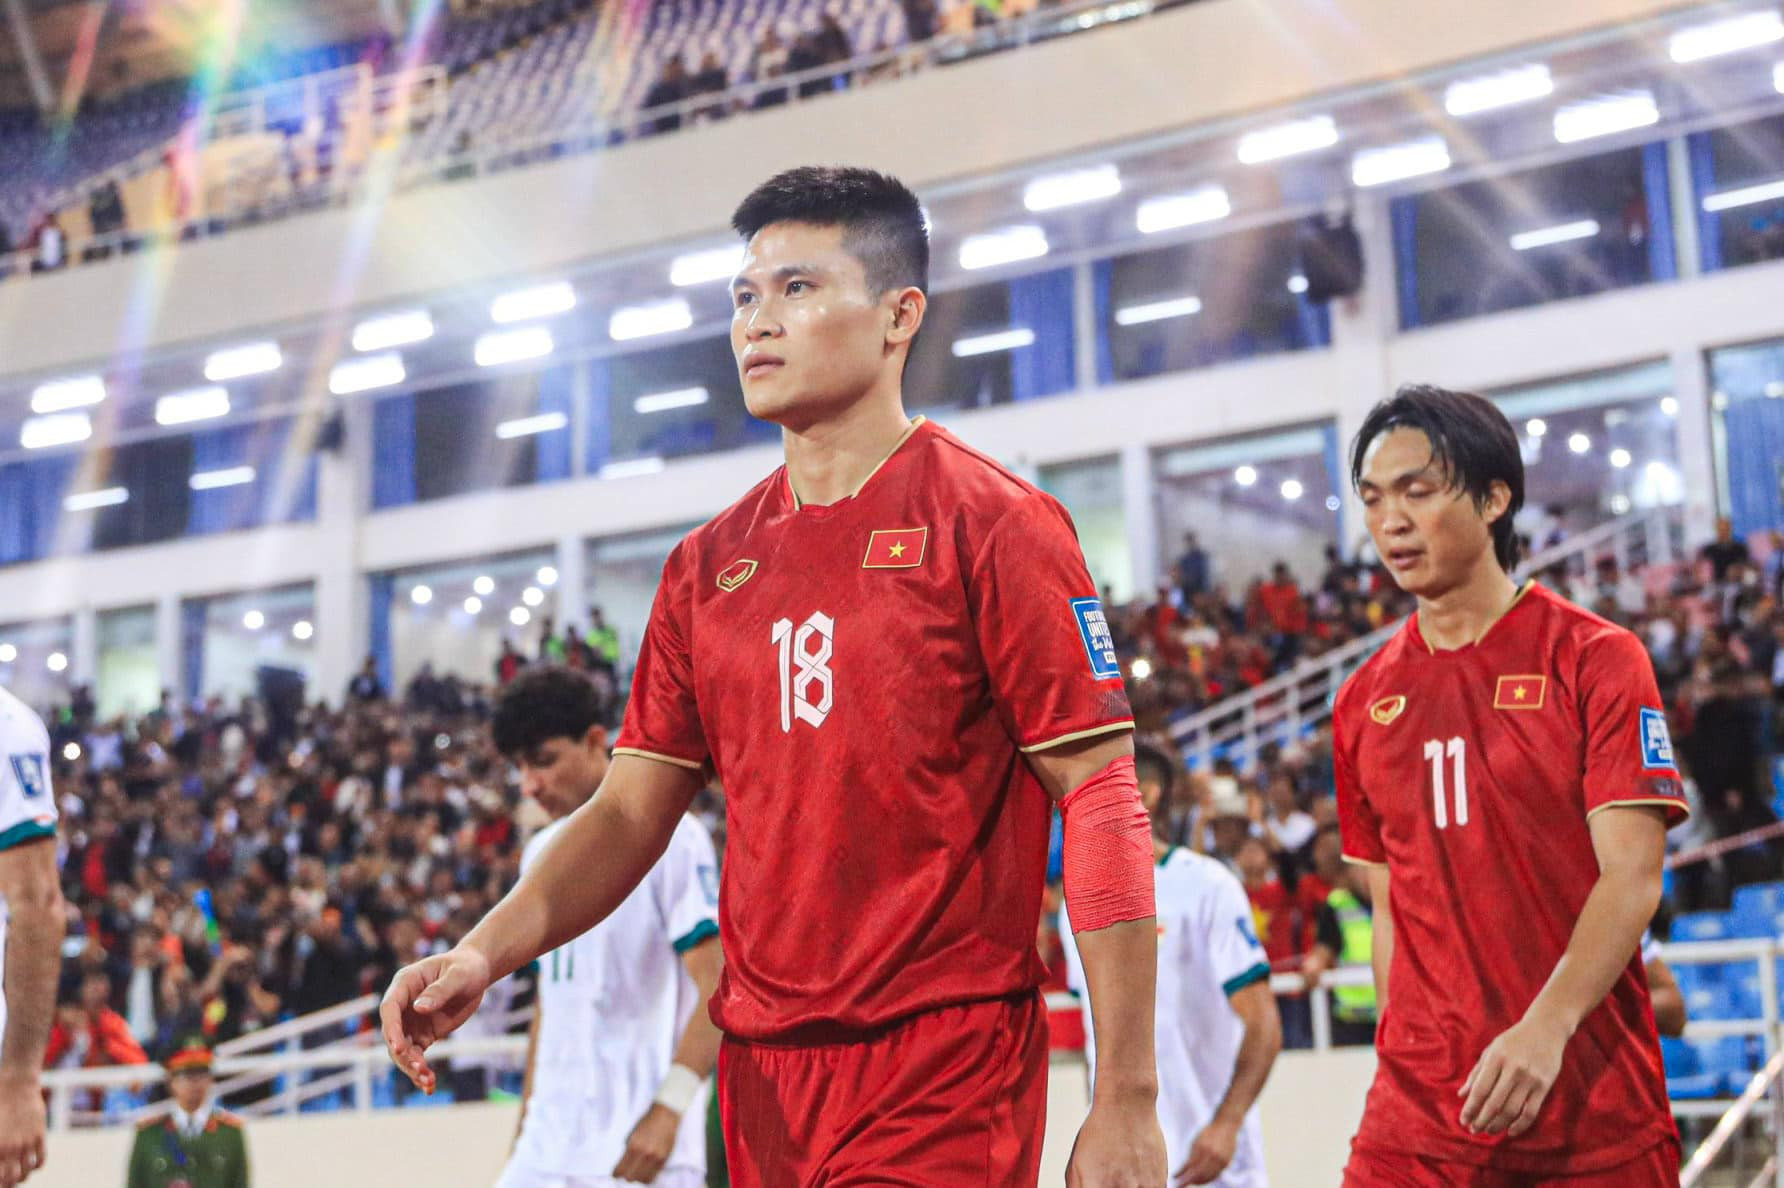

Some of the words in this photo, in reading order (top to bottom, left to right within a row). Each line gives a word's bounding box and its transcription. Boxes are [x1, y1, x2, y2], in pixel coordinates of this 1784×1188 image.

[771, 610, 835, 733] 18
[1087, 622, 1111, 637] UNITE
[1423, 736, 1469, 830] 11
